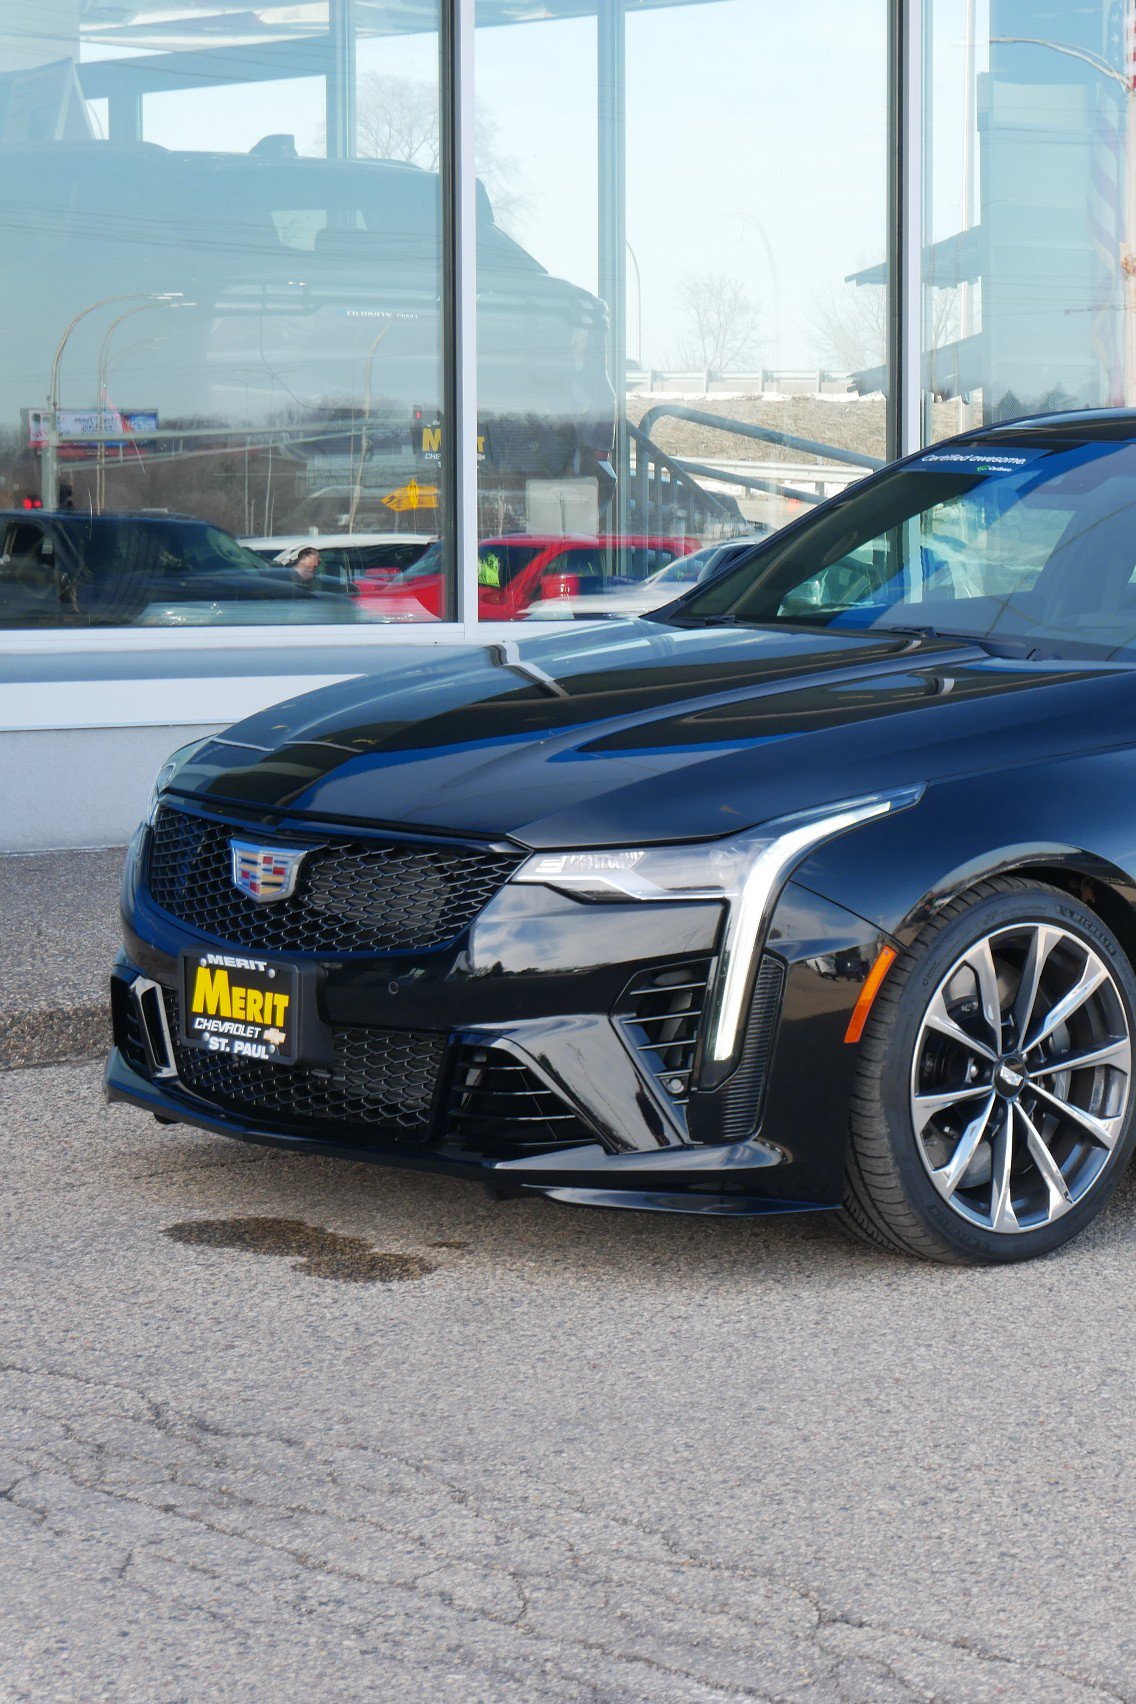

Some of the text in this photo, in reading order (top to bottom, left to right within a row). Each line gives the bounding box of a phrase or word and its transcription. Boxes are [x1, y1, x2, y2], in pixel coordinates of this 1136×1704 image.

[207, 954, 267, 971] MERIT
[192, 966, 289, 1027] MERIT
[195, 1018, 261, 1038] CHEVROLET
[208, 1036, 270, 1060] ST. PAUL
